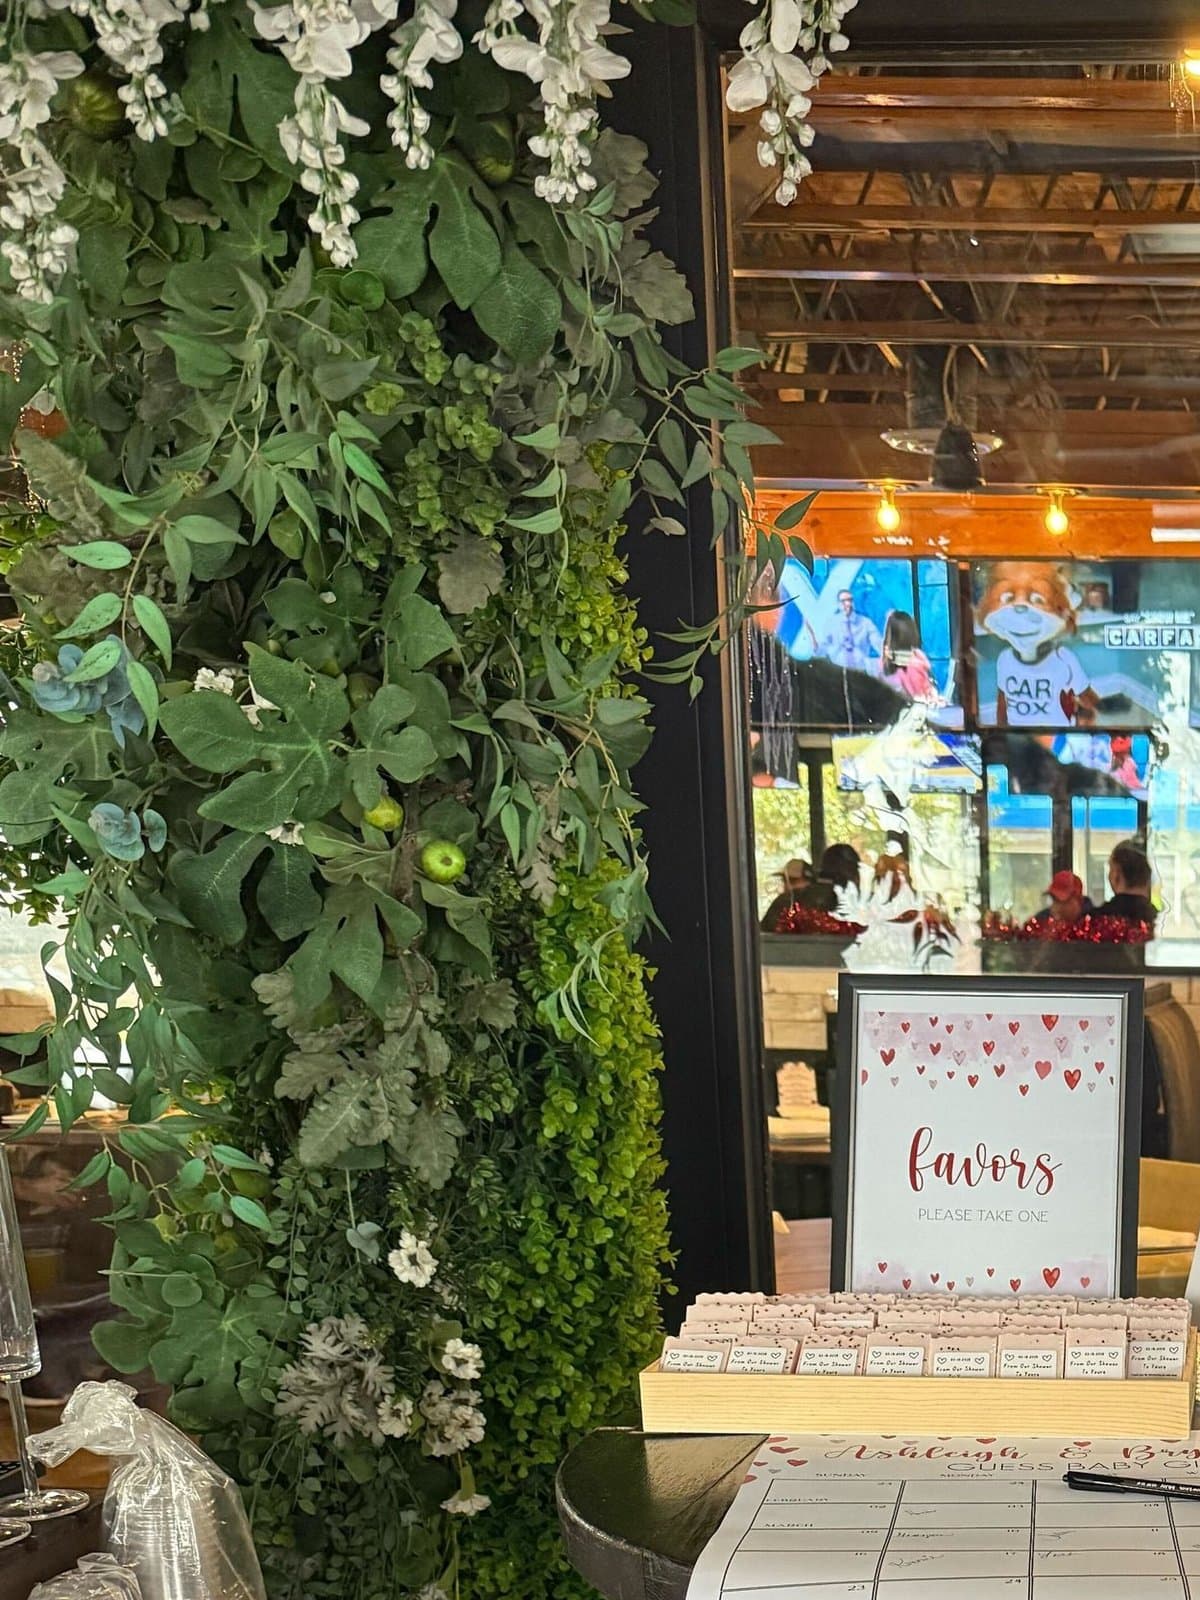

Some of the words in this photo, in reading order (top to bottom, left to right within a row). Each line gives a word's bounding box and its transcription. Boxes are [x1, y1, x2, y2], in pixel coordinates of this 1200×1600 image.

[1005, 676, 1051, 699] CAR
[908, 1126, 1063, 1196] favors
[918, 1208, 972, 1222] PLEASE
[977, 1209, 1013, 1222] TAKE
[1018, 1210, 1049, 1223] ONE
[824, 1444, 1029, 1463] Ashleigh
[1060, 1446, 1091, 1459] &
[948, 1462, 1054, 1471] GUESS
[1067, 1461, 1149, 1471] BABY
[848, 1584, 865, 1592] 23
